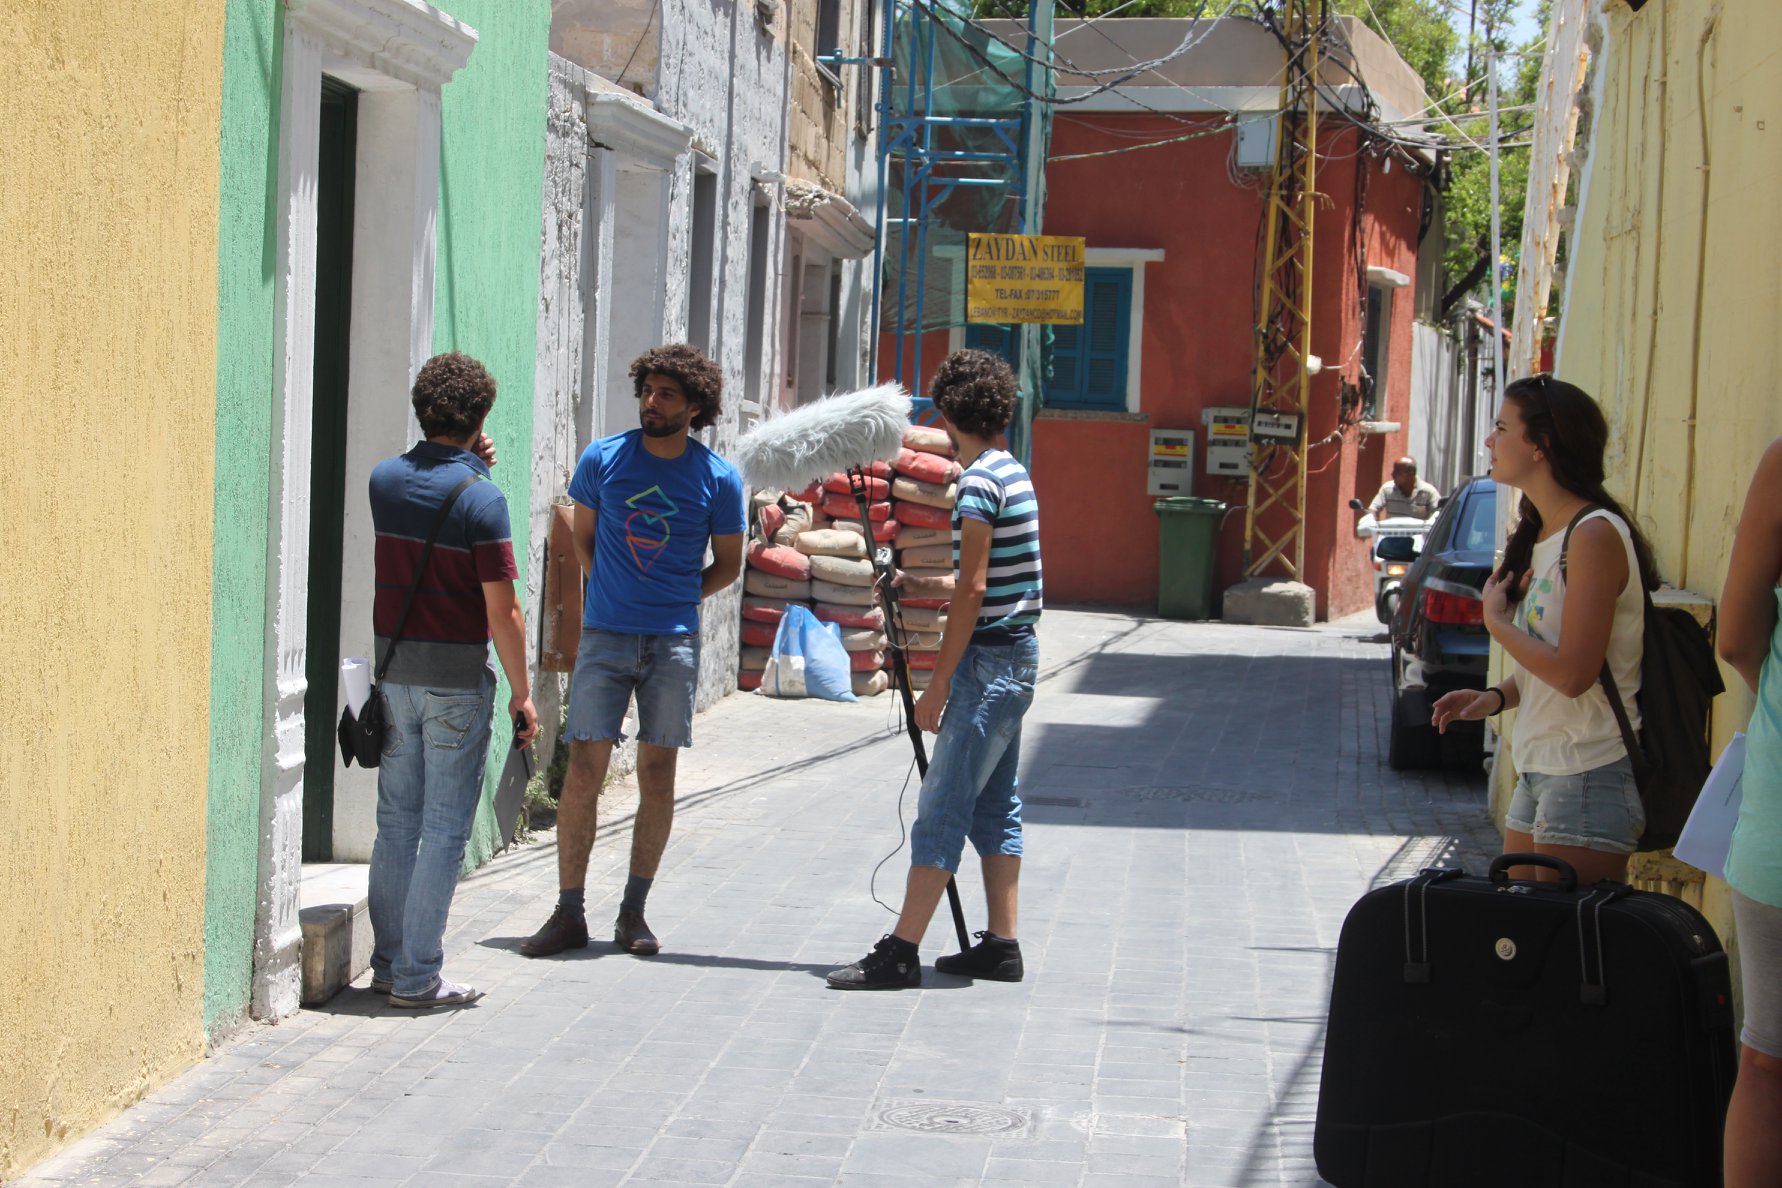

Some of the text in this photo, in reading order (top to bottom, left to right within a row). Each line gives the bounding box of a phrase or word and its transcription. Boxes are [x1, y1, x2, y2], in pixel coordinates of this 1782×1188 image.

[972, 237, 1079, 262] ZAYDAN STEEL
[994, 288, 1023, 300] TEL-FAX
